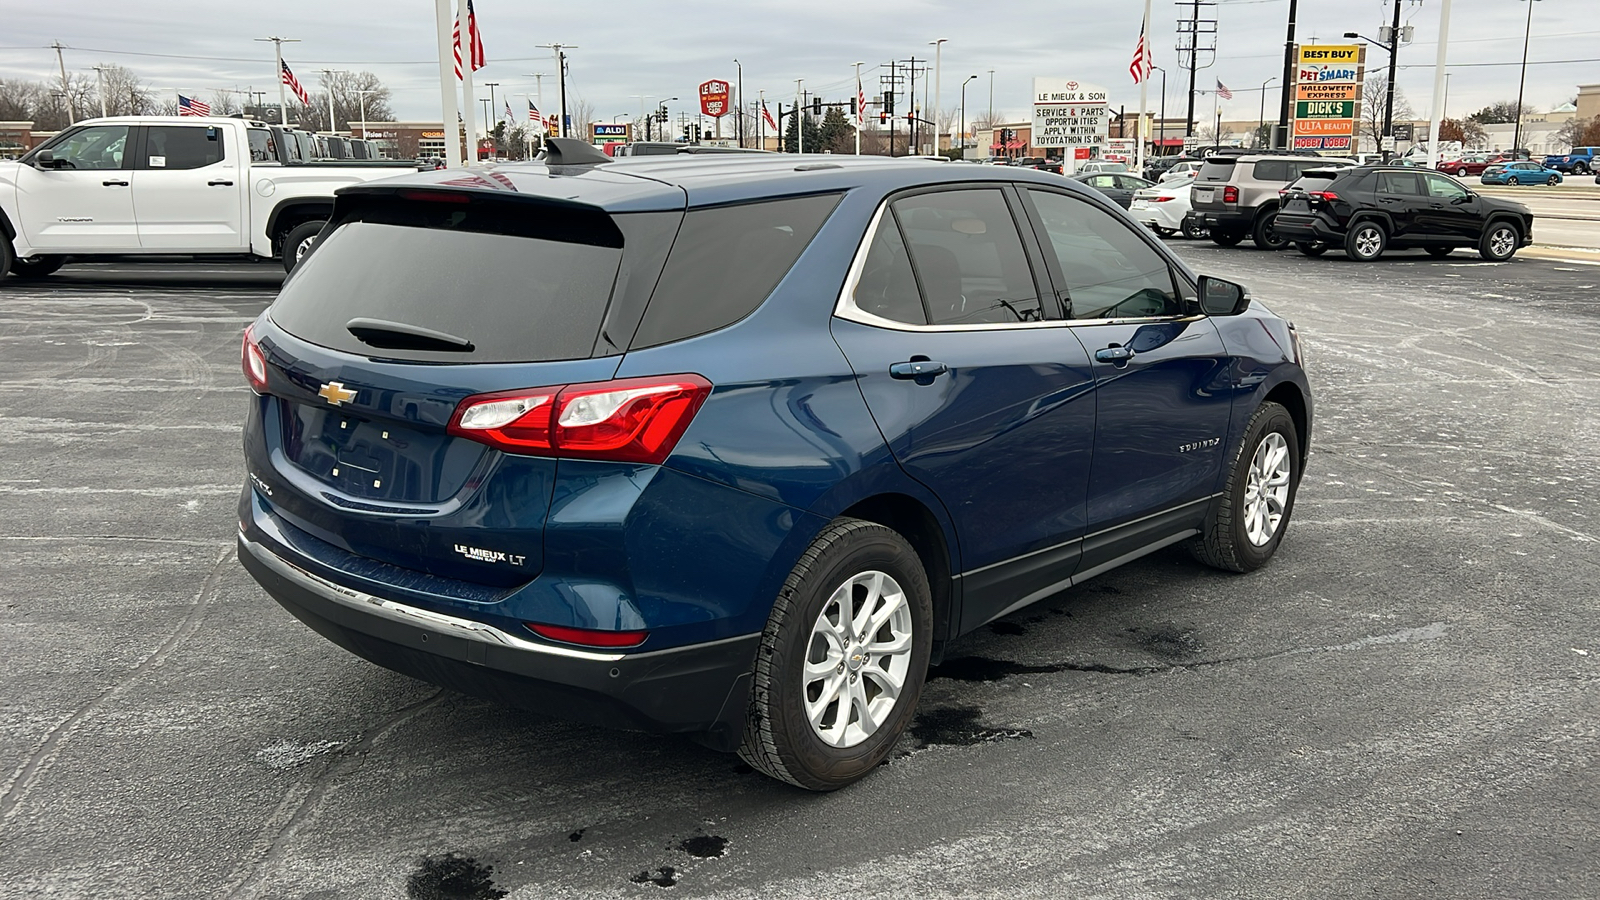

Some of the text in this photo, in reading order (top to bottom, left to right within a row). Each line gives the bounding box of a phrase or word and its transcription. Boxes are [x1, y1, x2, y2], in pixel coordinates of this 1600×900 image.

[1300, 69, 1355, 81] PETSMART
[701, 82, 726, 95] LE MIEUX
[1038, 93, 1049, 101] LE
[1051, 93, 1076, 101] MIEUX
[1036, 107, 1104, 117] SERVICE & PARTS
[1307, 102, 1344, 114] DICK'S
[1045, 117, 1099, 126] OPPORTUNITIES
[1298, 121, 1322, 131] ULTA
[1044, 126, 1096, 135] APPLY WITHIN
[1037, 136, 1082, 144] TOYOTATHON
[1295, 138, 1350, 148] HOBBY LOBBY
[1179, 437, 1220, 453] EQUINOX
[454, 544, 507, 562] LE MIEUX
[509, 554, 526, 566] LT
